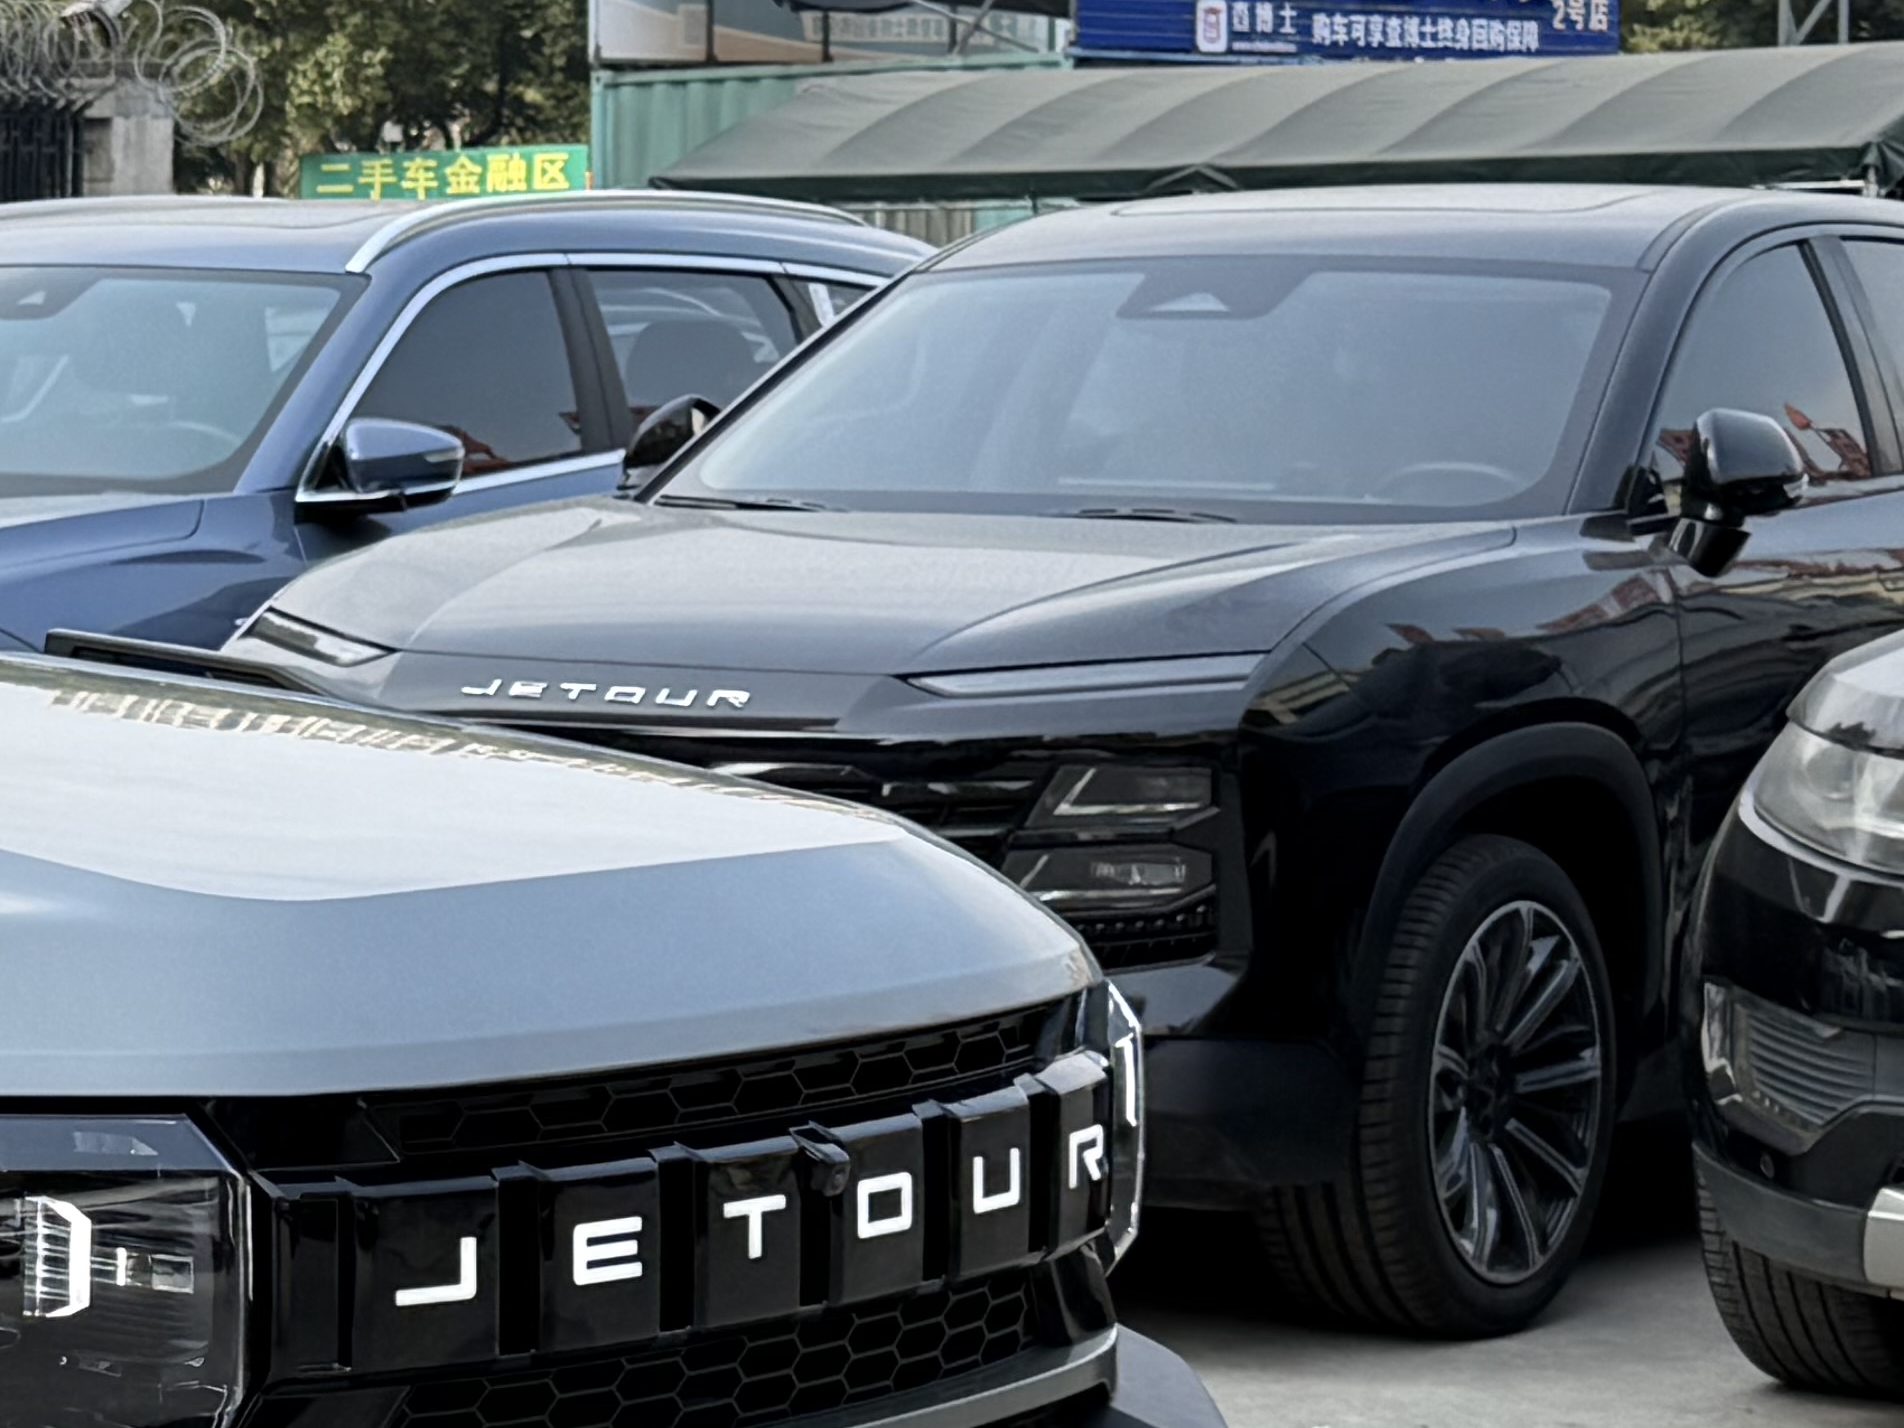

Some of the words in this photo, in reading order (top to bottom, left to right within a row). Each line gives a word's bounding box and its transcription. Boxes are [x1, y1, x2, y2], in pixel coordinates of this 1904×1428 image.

[316, 152, 570, 200] 二手车金融区
[460, 678, 751, 708] JETOUR
[394, 1124, 1104, 1306] JETOUR
